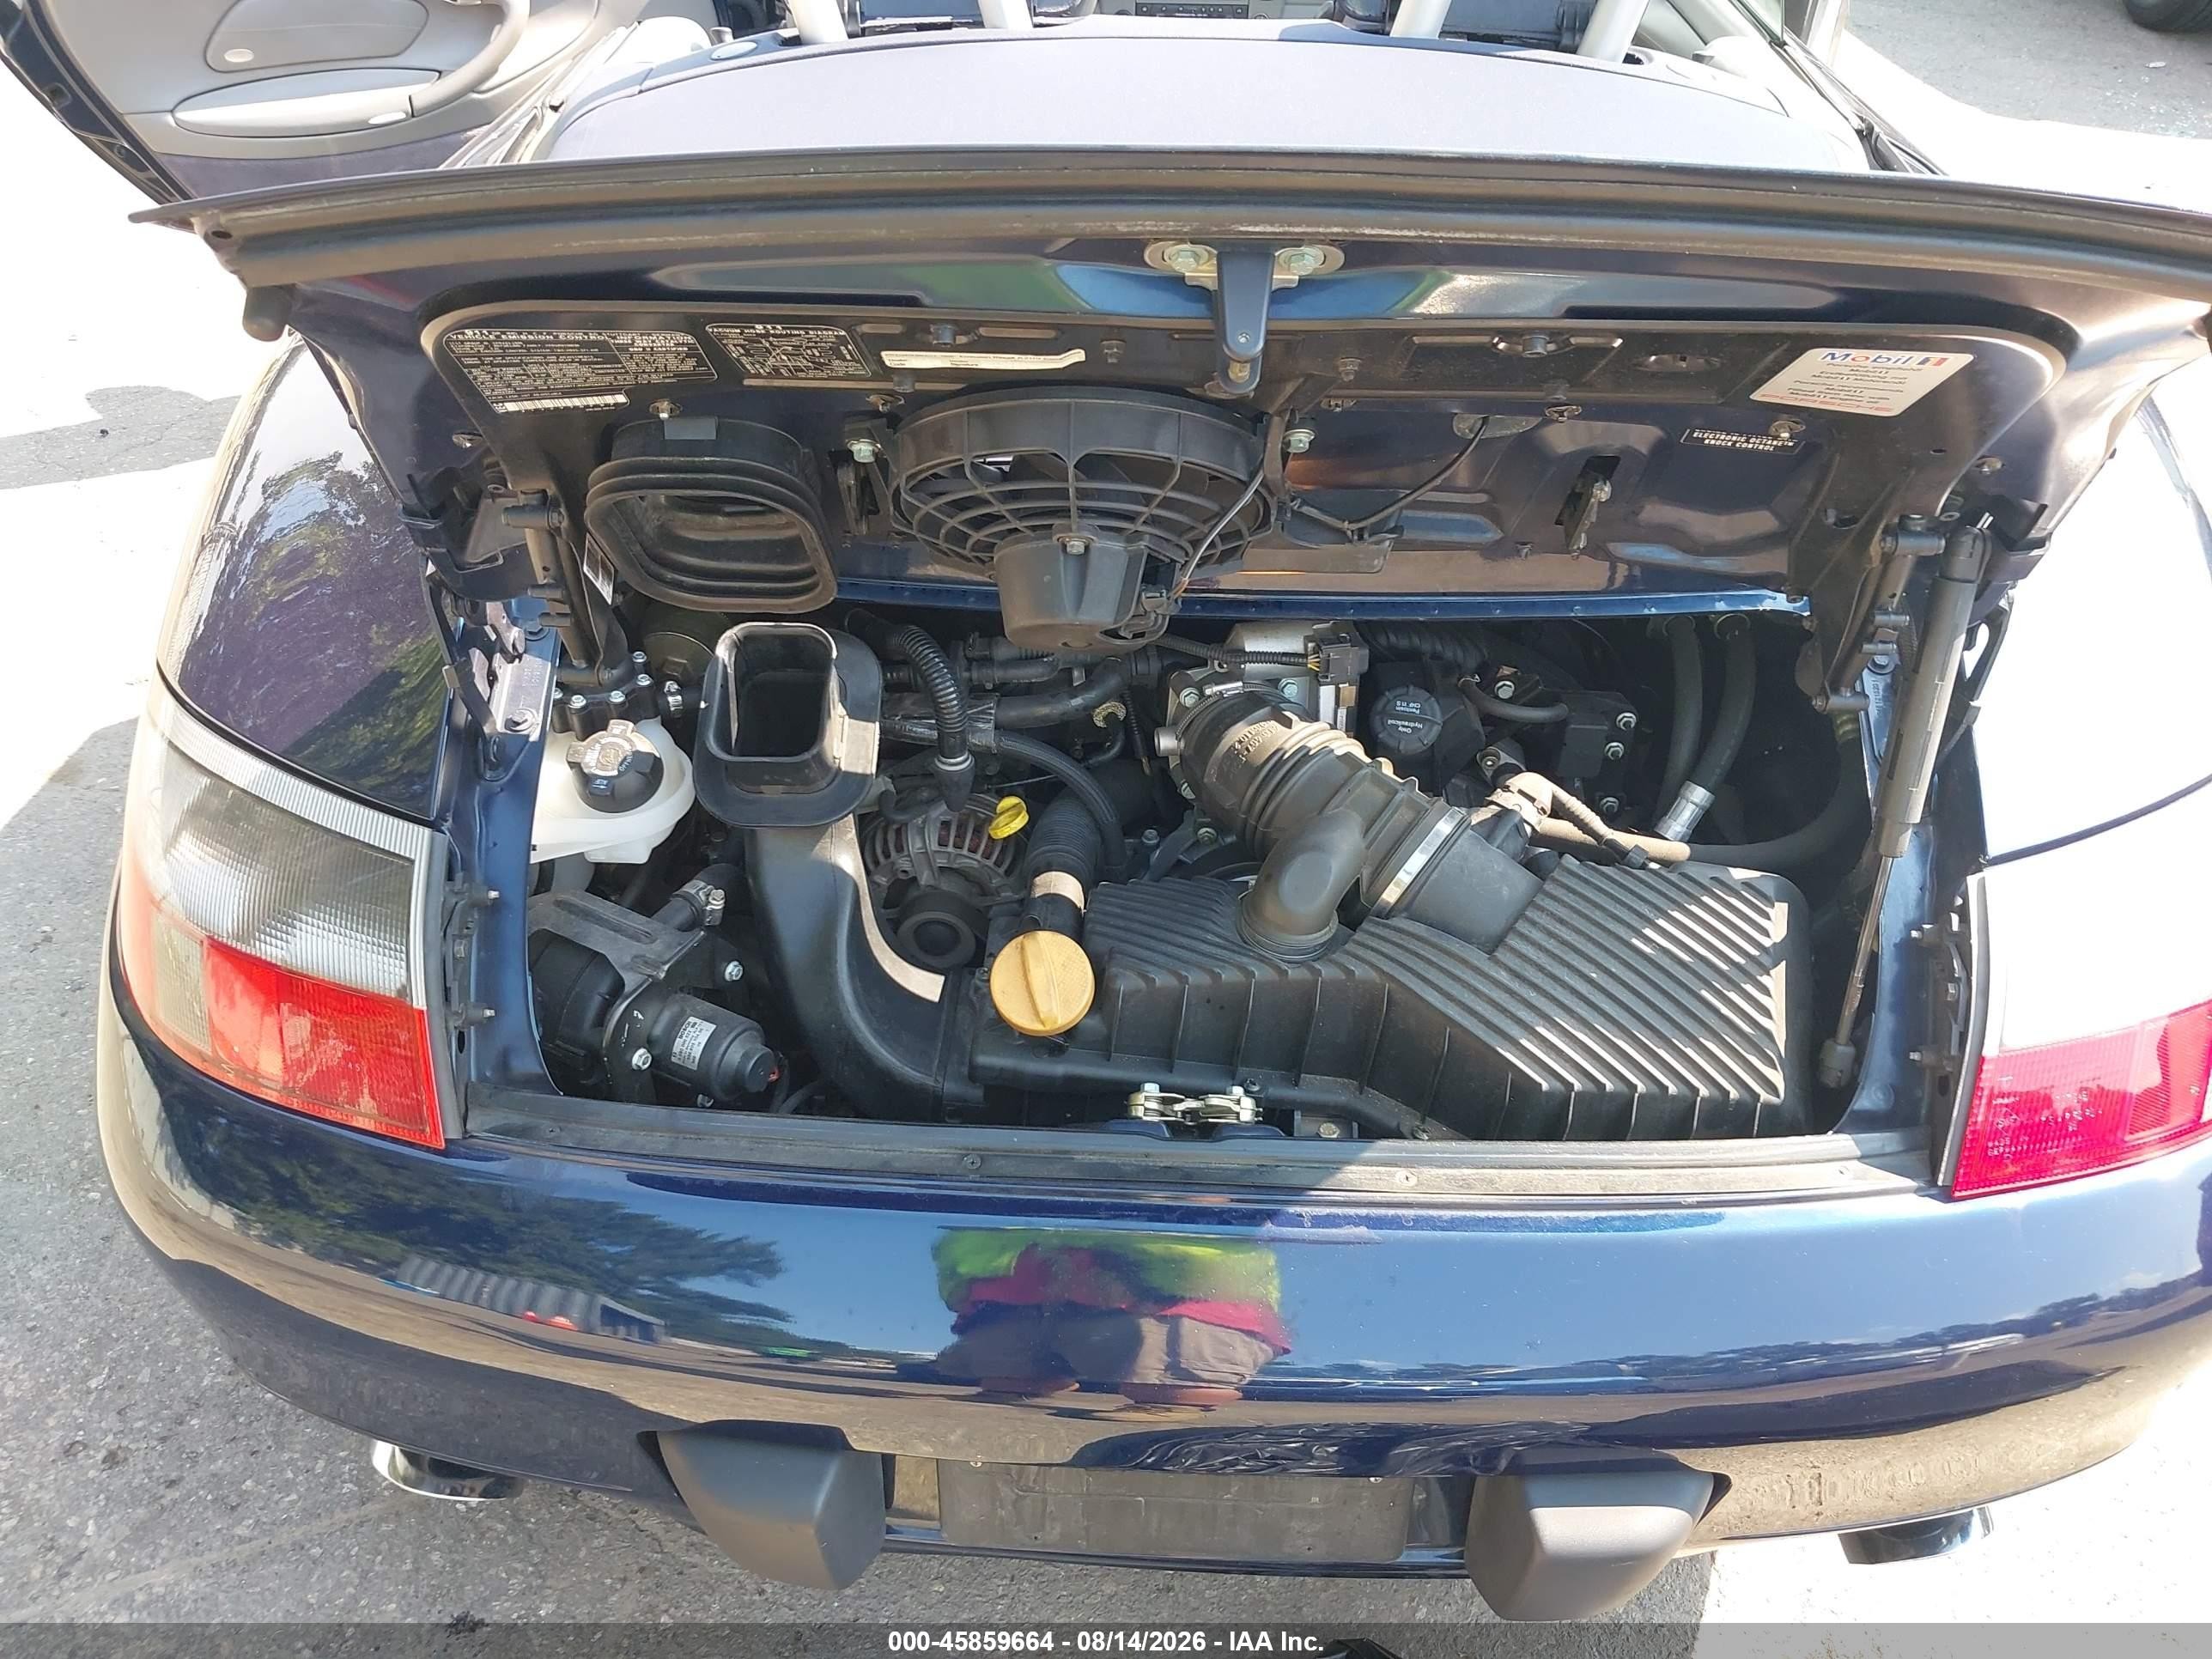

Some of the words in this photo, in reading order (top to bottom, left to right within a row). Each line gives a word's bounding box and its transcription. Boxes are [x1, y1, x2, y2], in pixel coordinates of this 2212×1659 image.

[1820, 351, 1913, 365] Mobil
[1759, 393, 1893, 413] PORSCHE
[1692, 431, 1747, 442] ELECTRONIC
[1704, 439, 1732, 447] KNOCK
[1735, 441, 1775, 452] CONTROL
[1398, 726, 1413, 734] Only
